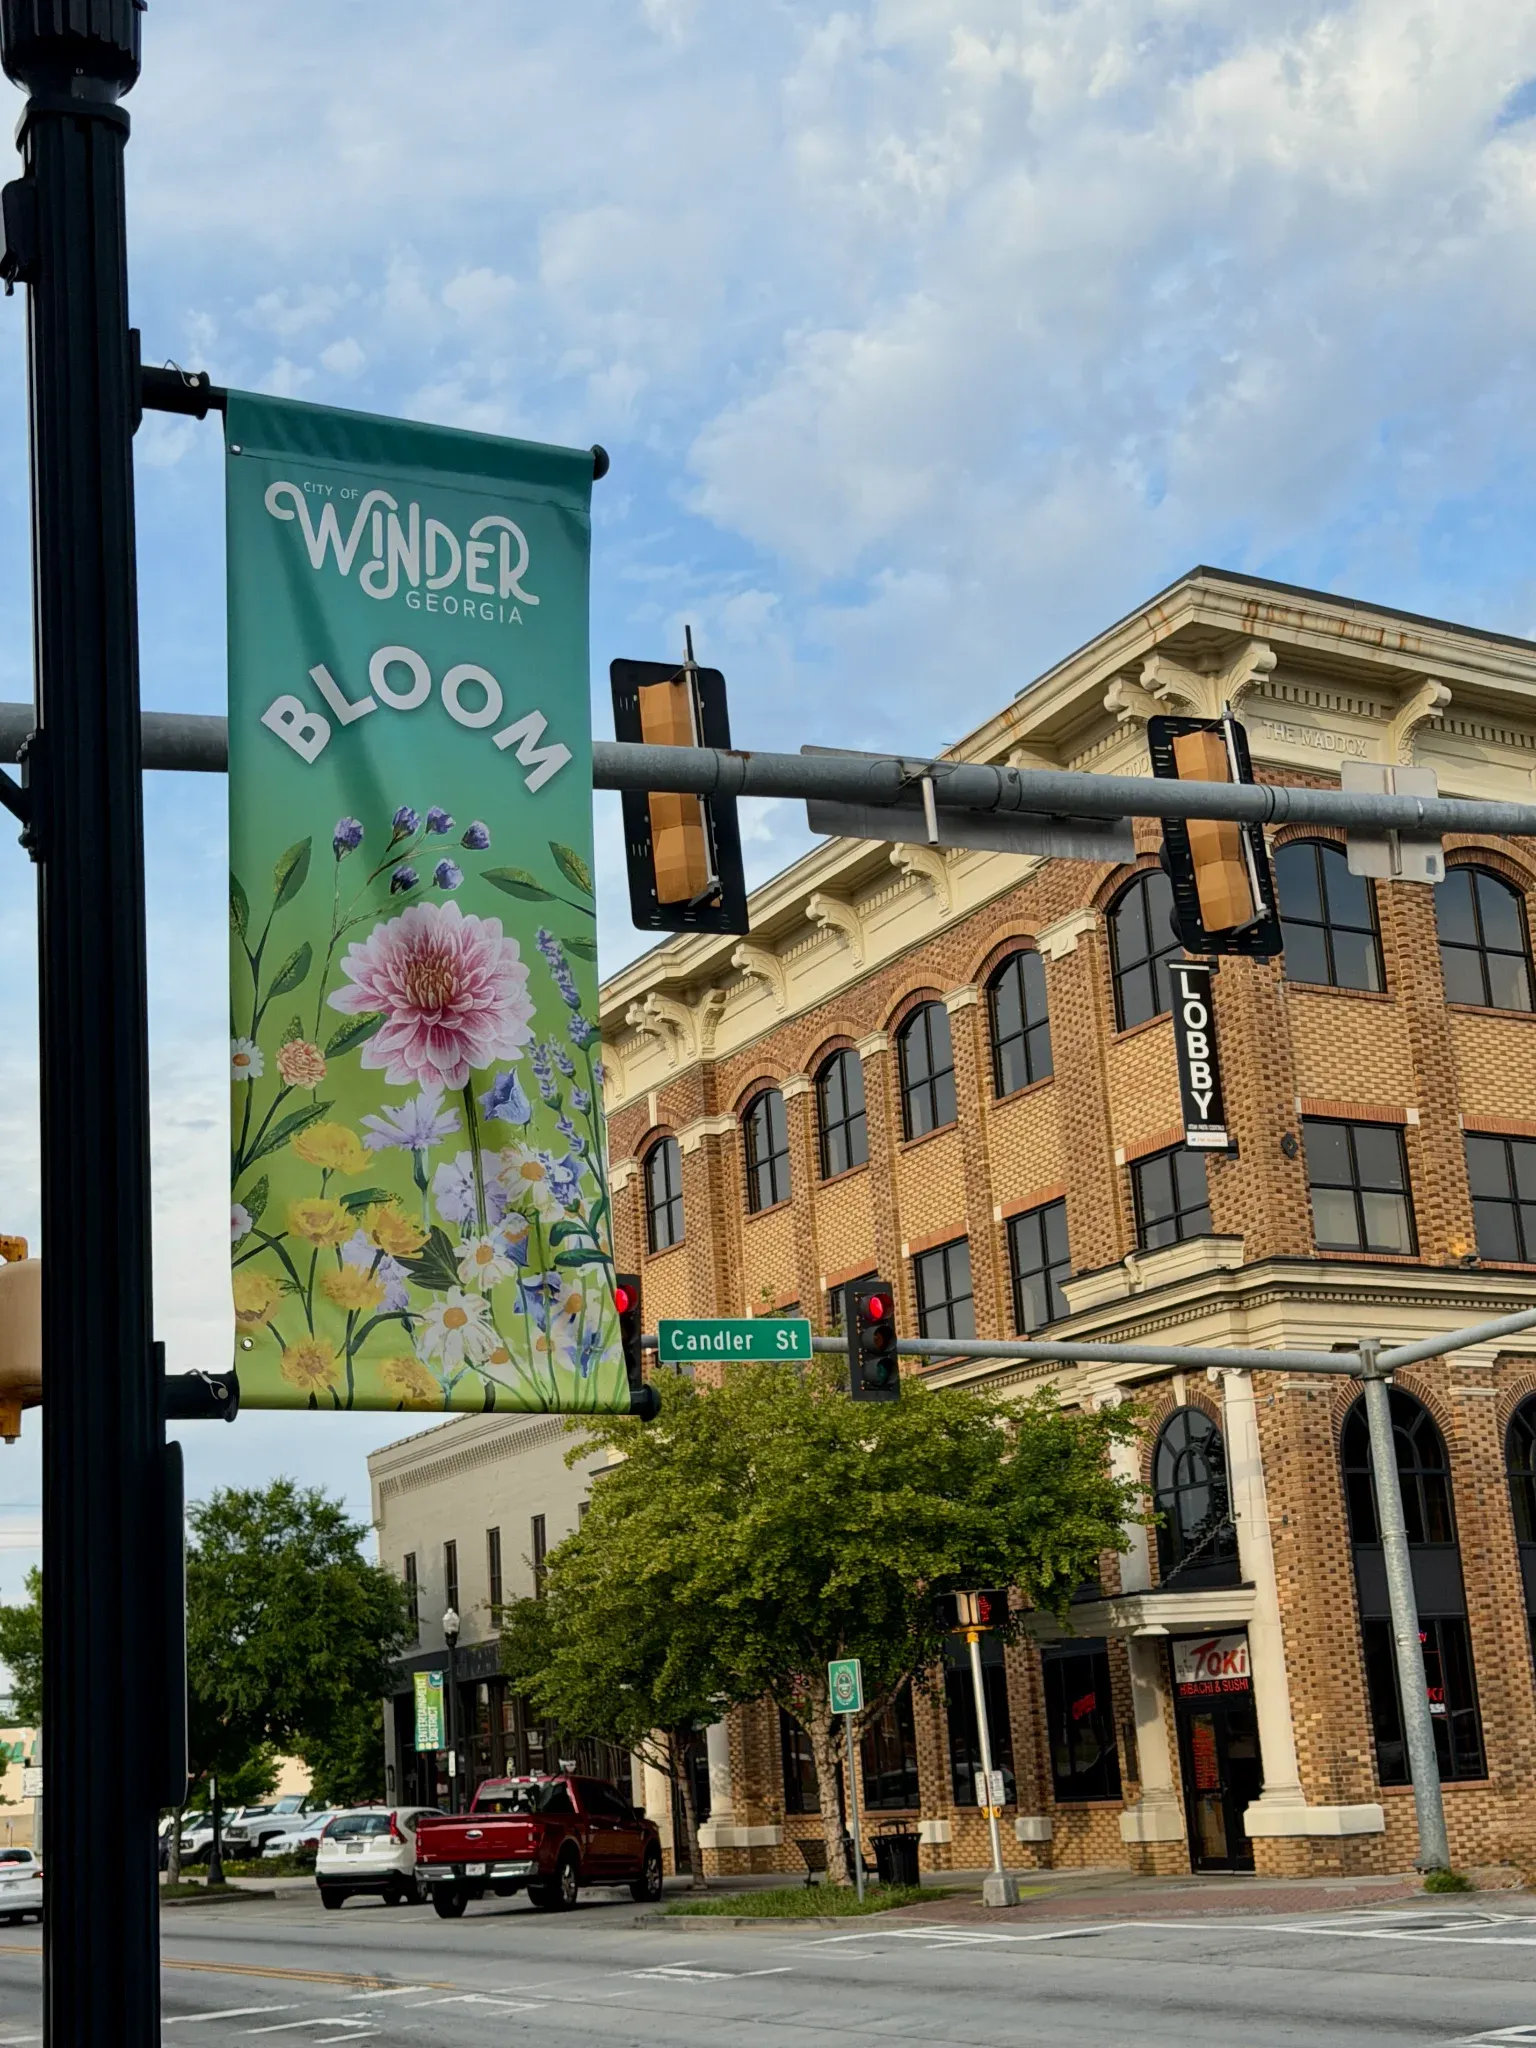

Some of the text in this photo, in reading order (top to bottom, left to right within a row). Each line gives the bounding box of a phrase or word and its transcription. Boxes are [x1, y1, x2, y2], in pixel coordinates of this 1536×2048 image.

[303, 481, 360, 500] CITY OF
[264, 481, 540, 605] WINDER
[405, 590, 524, 625] GEORGIA
[261, 646, 573, 793] BLOOM
[1262, 720, 1368, 758] THE MADDOX
[1180, 971, 1213, 1120] LOBBY
[671, 1329, 799, 1351] Candler St
[1180, 1678, 1249, 1696] HIBACHI & SUSHI
[415, 1678, 428, 1742] ENTERTAINMENT
[428, 1706, 439, 1741] DISTRICT
